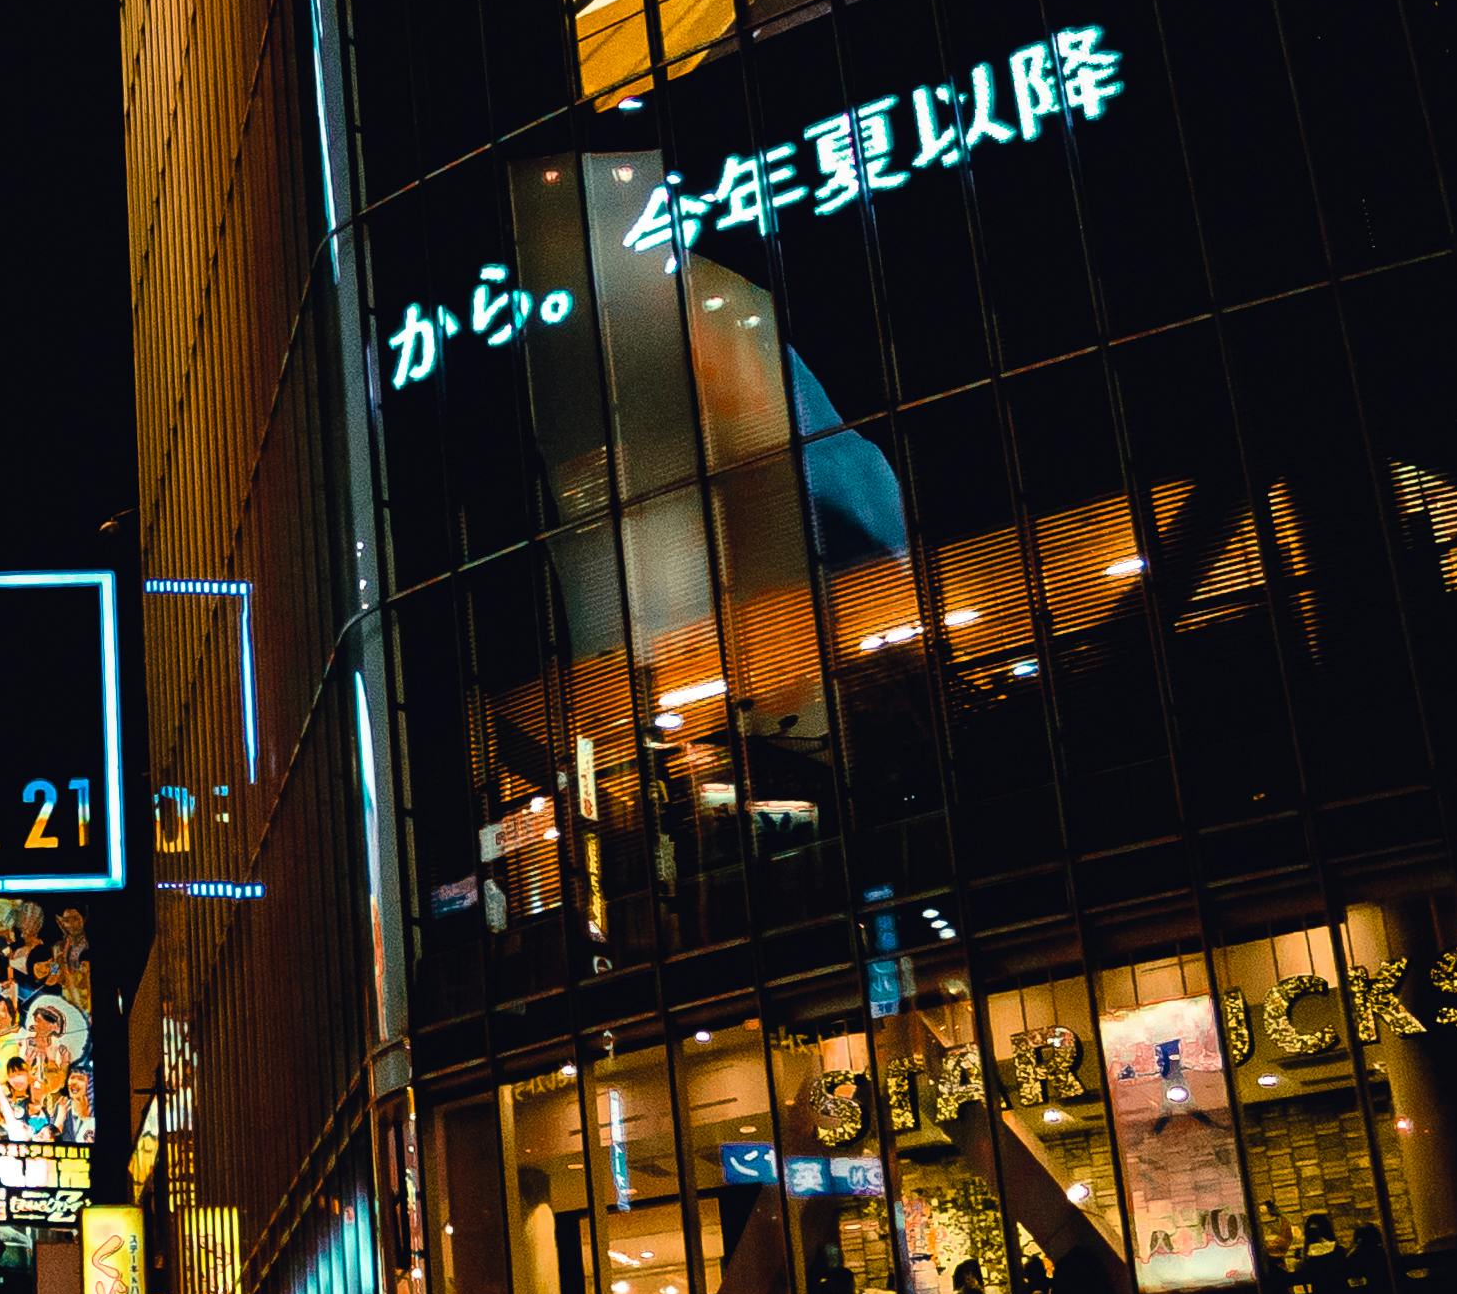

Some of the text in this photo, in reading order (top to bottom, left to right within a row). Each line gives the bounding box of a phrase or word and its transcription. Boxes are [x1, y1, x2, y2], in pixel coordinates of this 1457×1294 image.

[622, 24, 1127, 275] 今年夏以降
[388, 263, 575, 391] から。
[22, 778, 90, 849] 21
